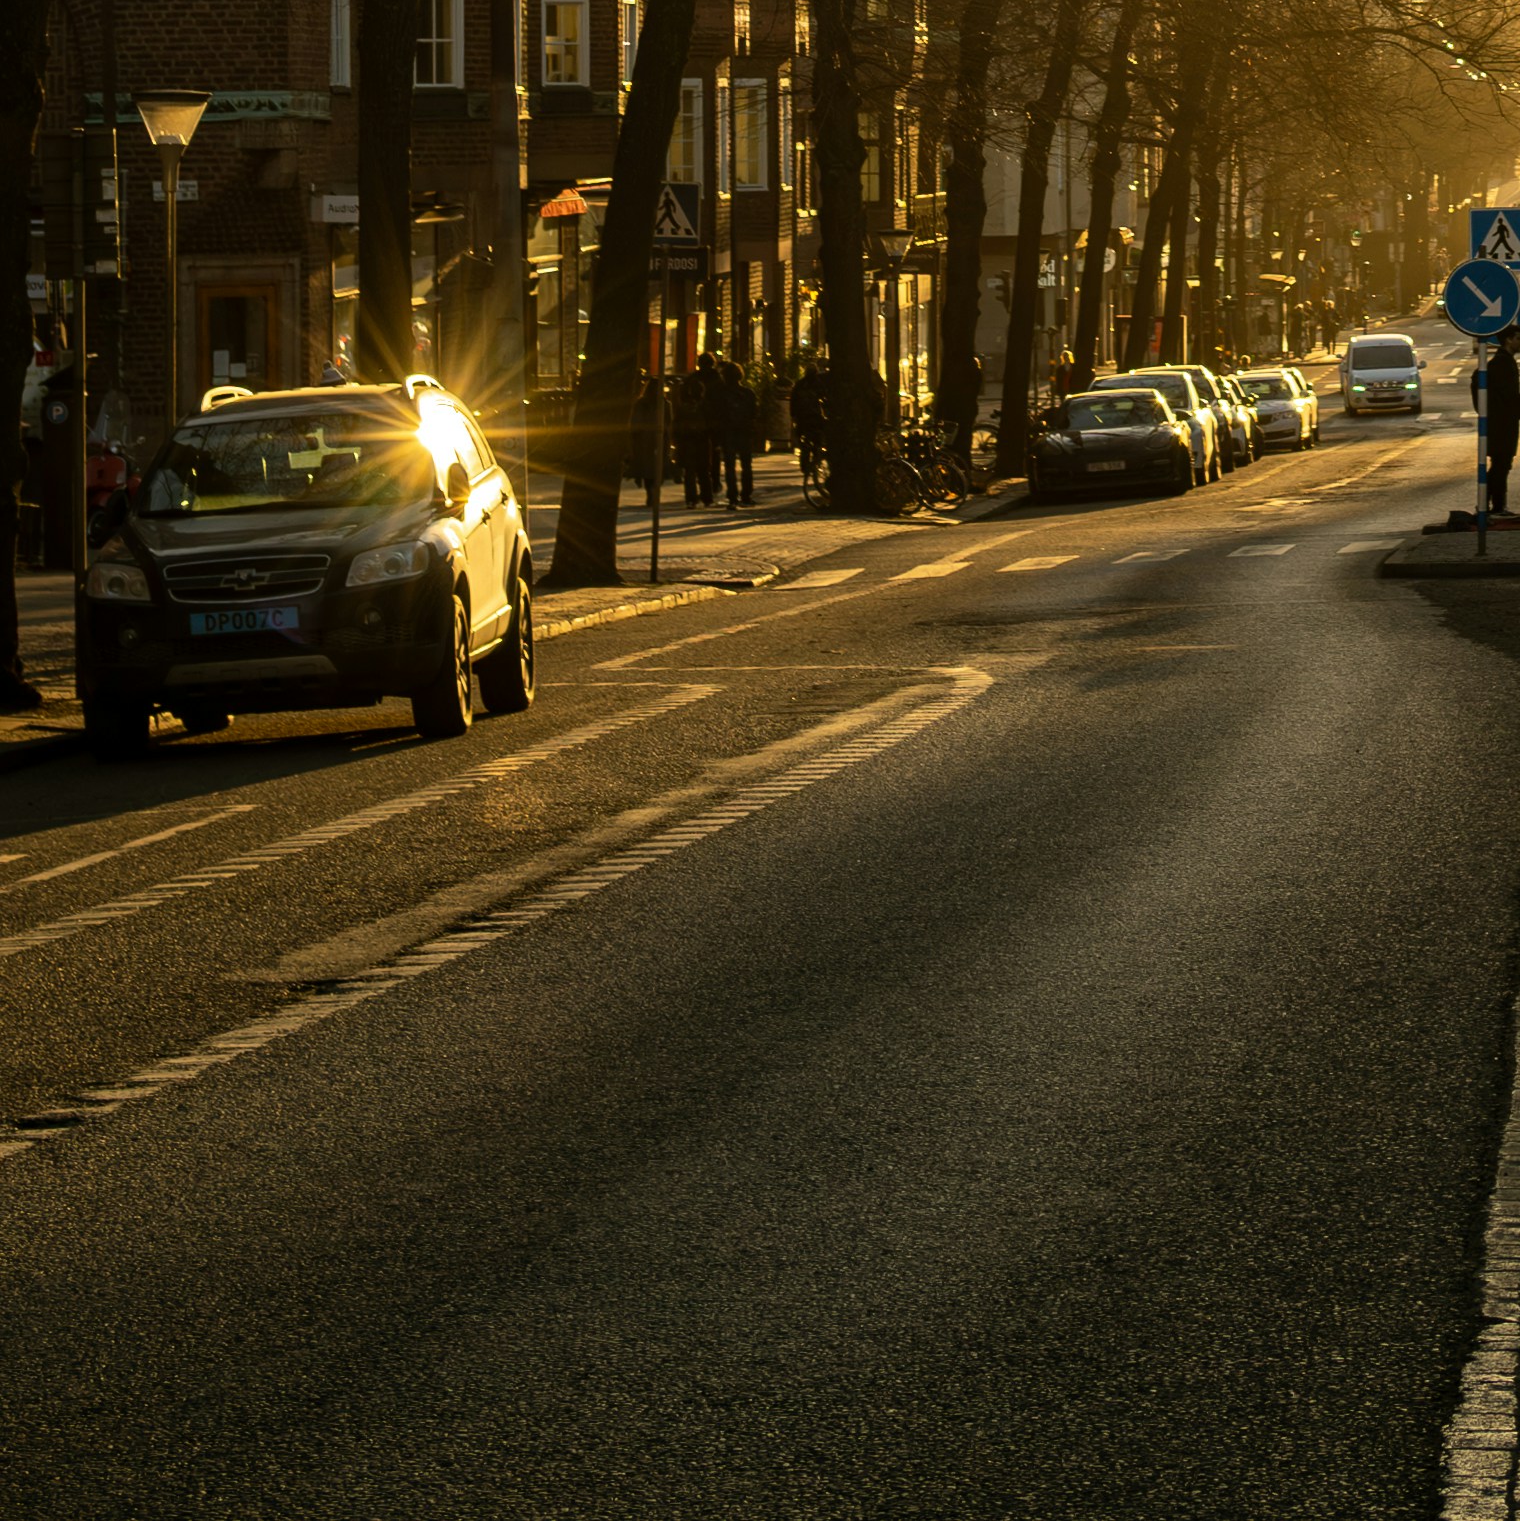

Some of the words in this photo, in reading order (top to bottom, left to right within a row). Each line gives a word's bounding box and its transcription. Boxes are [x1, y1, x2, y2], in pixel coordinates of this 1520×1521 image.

[655, 258, 698, 270] FRDOSI
[53, 406, 64, 420] P
[205, 609, 283, 631] DP007C
